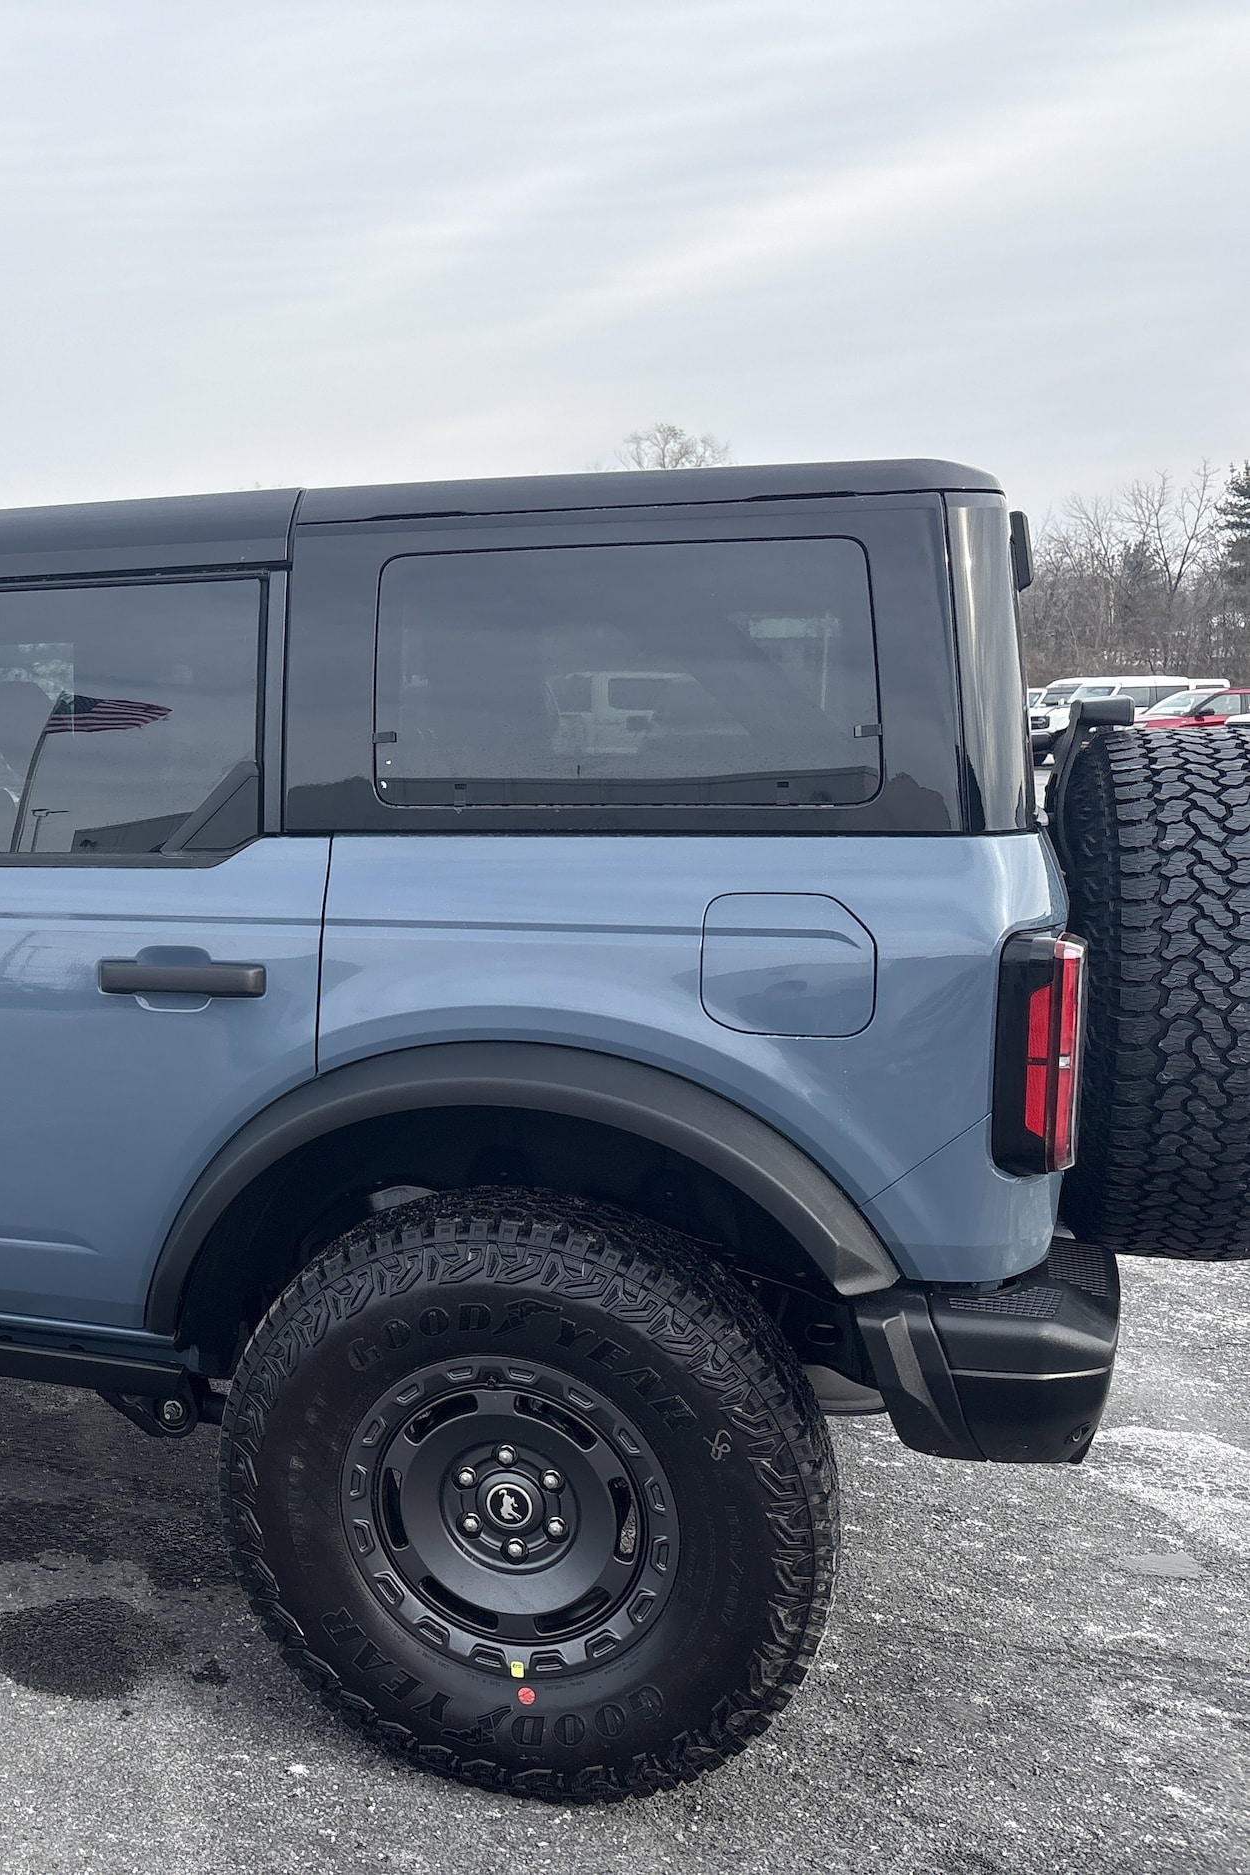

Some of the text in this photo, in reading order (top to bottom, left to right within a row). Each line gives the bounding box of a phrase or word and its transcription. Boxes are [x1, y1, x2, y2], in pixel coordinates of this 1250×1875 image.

[347, 1302, 699, 1434] GOOD YEAR
[320, 1606, 455, 1725] YEAR
[511, 1684, 665, 1749] GOOD
